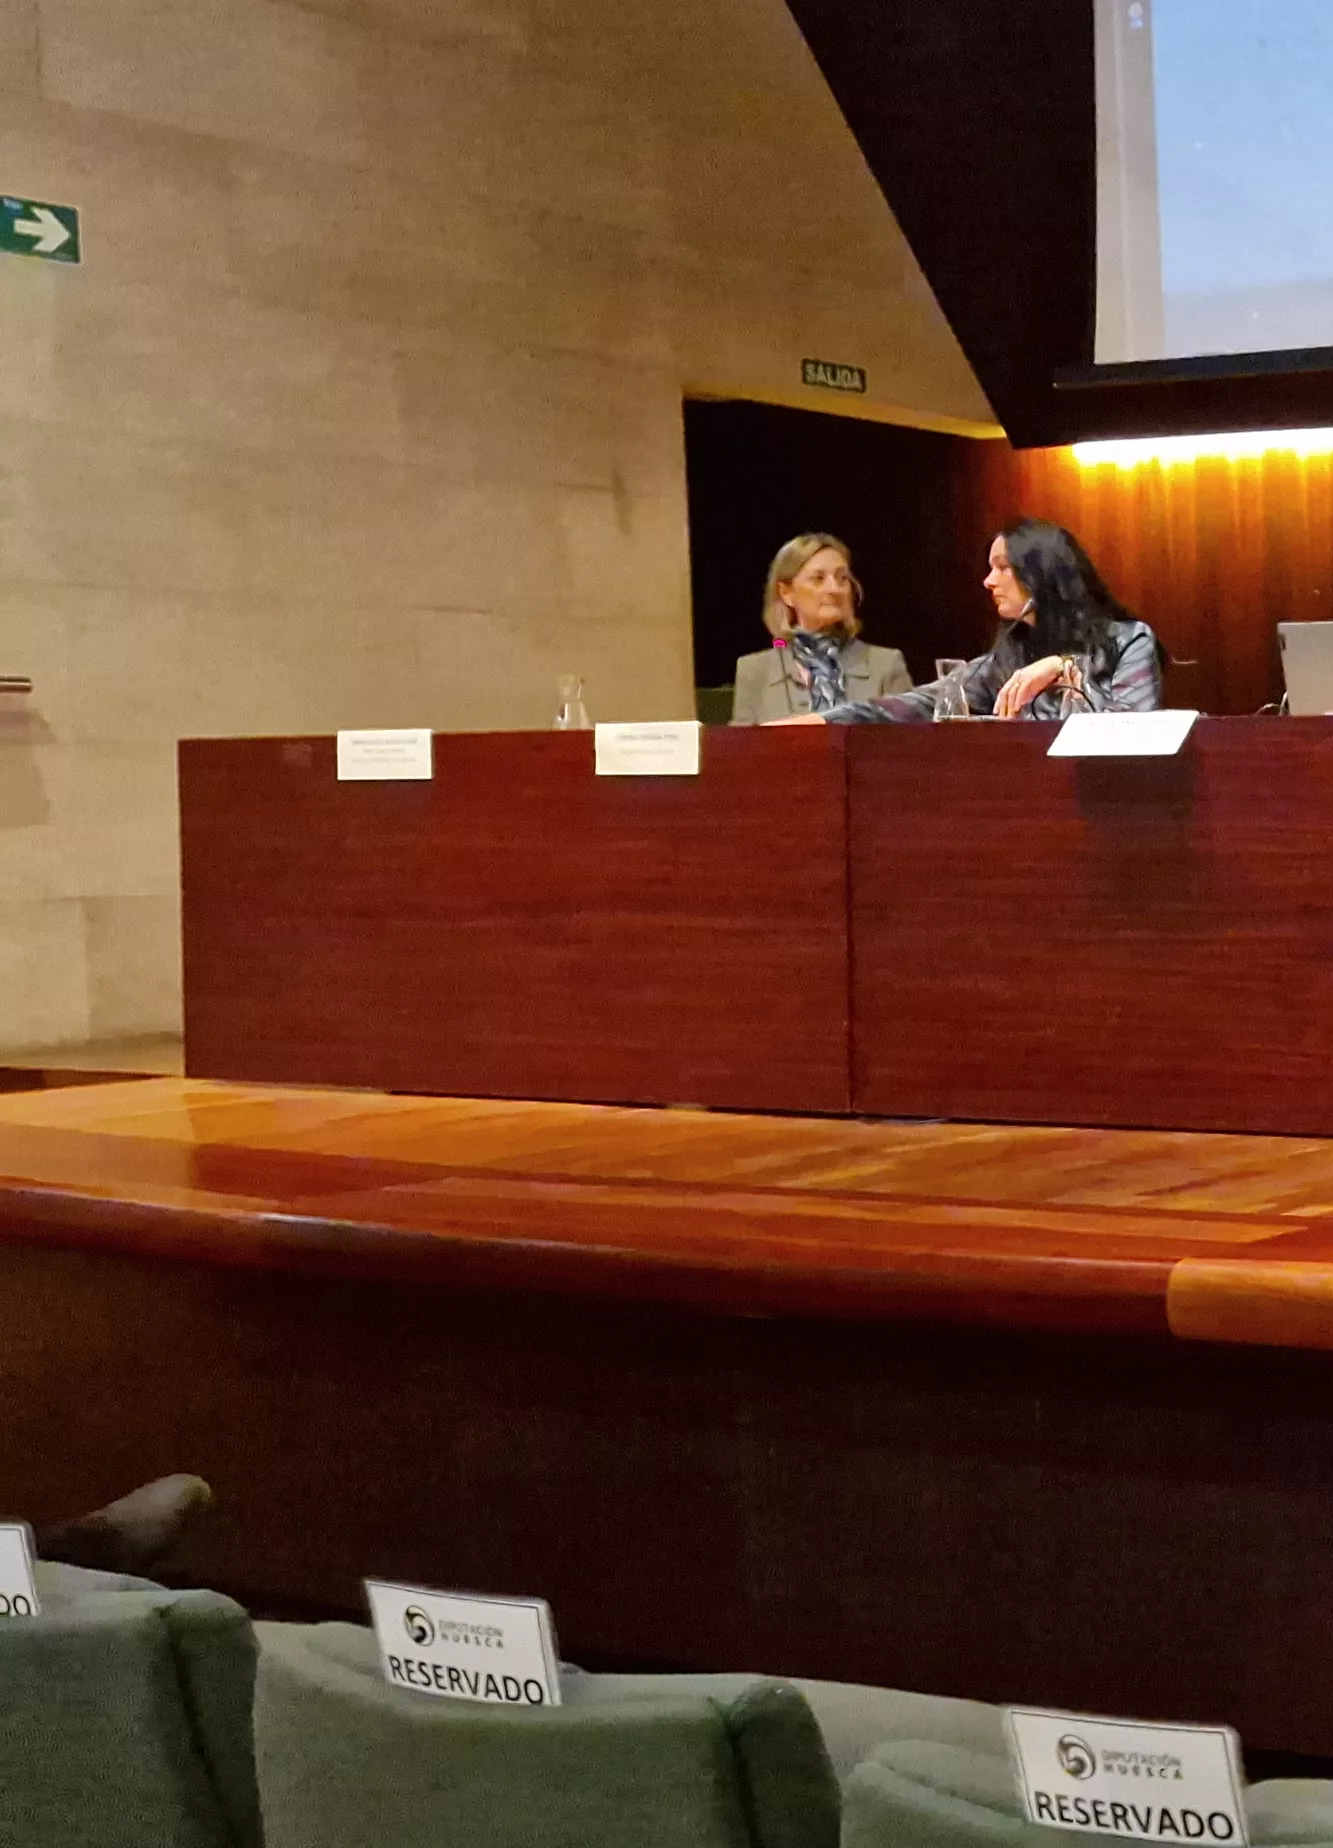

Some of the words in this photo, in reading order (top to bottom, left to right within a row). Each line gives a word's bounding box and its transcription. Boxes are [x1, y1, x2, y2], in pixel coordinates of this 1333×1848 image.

[804, 362, 863, 390] SALIDA
[388, 1655, 544, 1705] RESERVADO
[1034, 1791, 1233, 1840] RESERVADO
